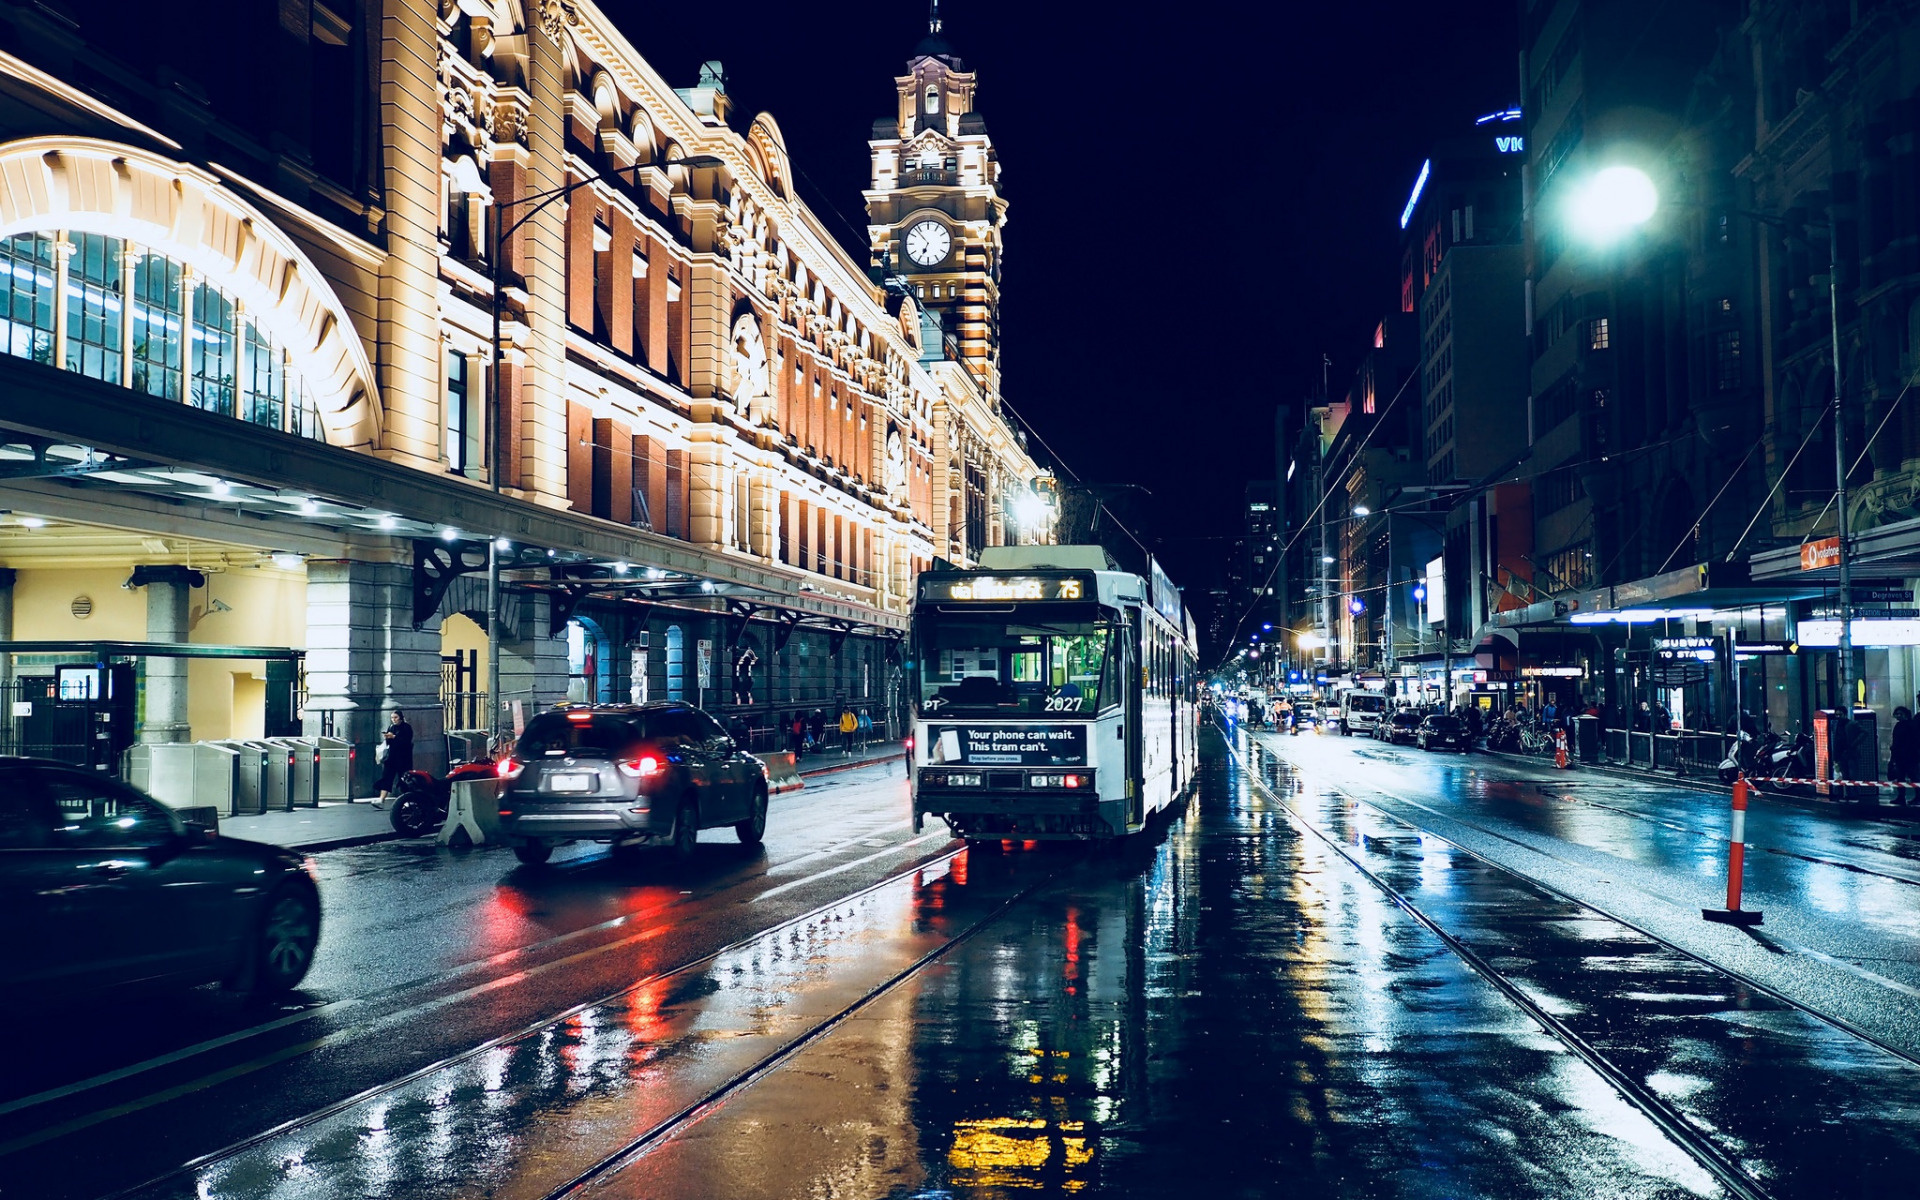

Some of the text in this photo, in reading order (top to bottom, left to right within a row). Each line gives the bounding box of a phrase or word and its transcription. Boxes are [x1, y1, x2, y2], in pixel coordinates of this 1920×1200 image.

[1817, 545, 1839, 559] vodafone
[1060, 580, 1080, 599] 75
[1661, 638, 1714, 648] SUBWAY
[1659, 650, 1673, 659] TO
[1044, 697, 1084, 712] 2027
[967, 729, 1076, 742] Your phone can wait.
[967, 741, 1049, 751] This tram can't.
